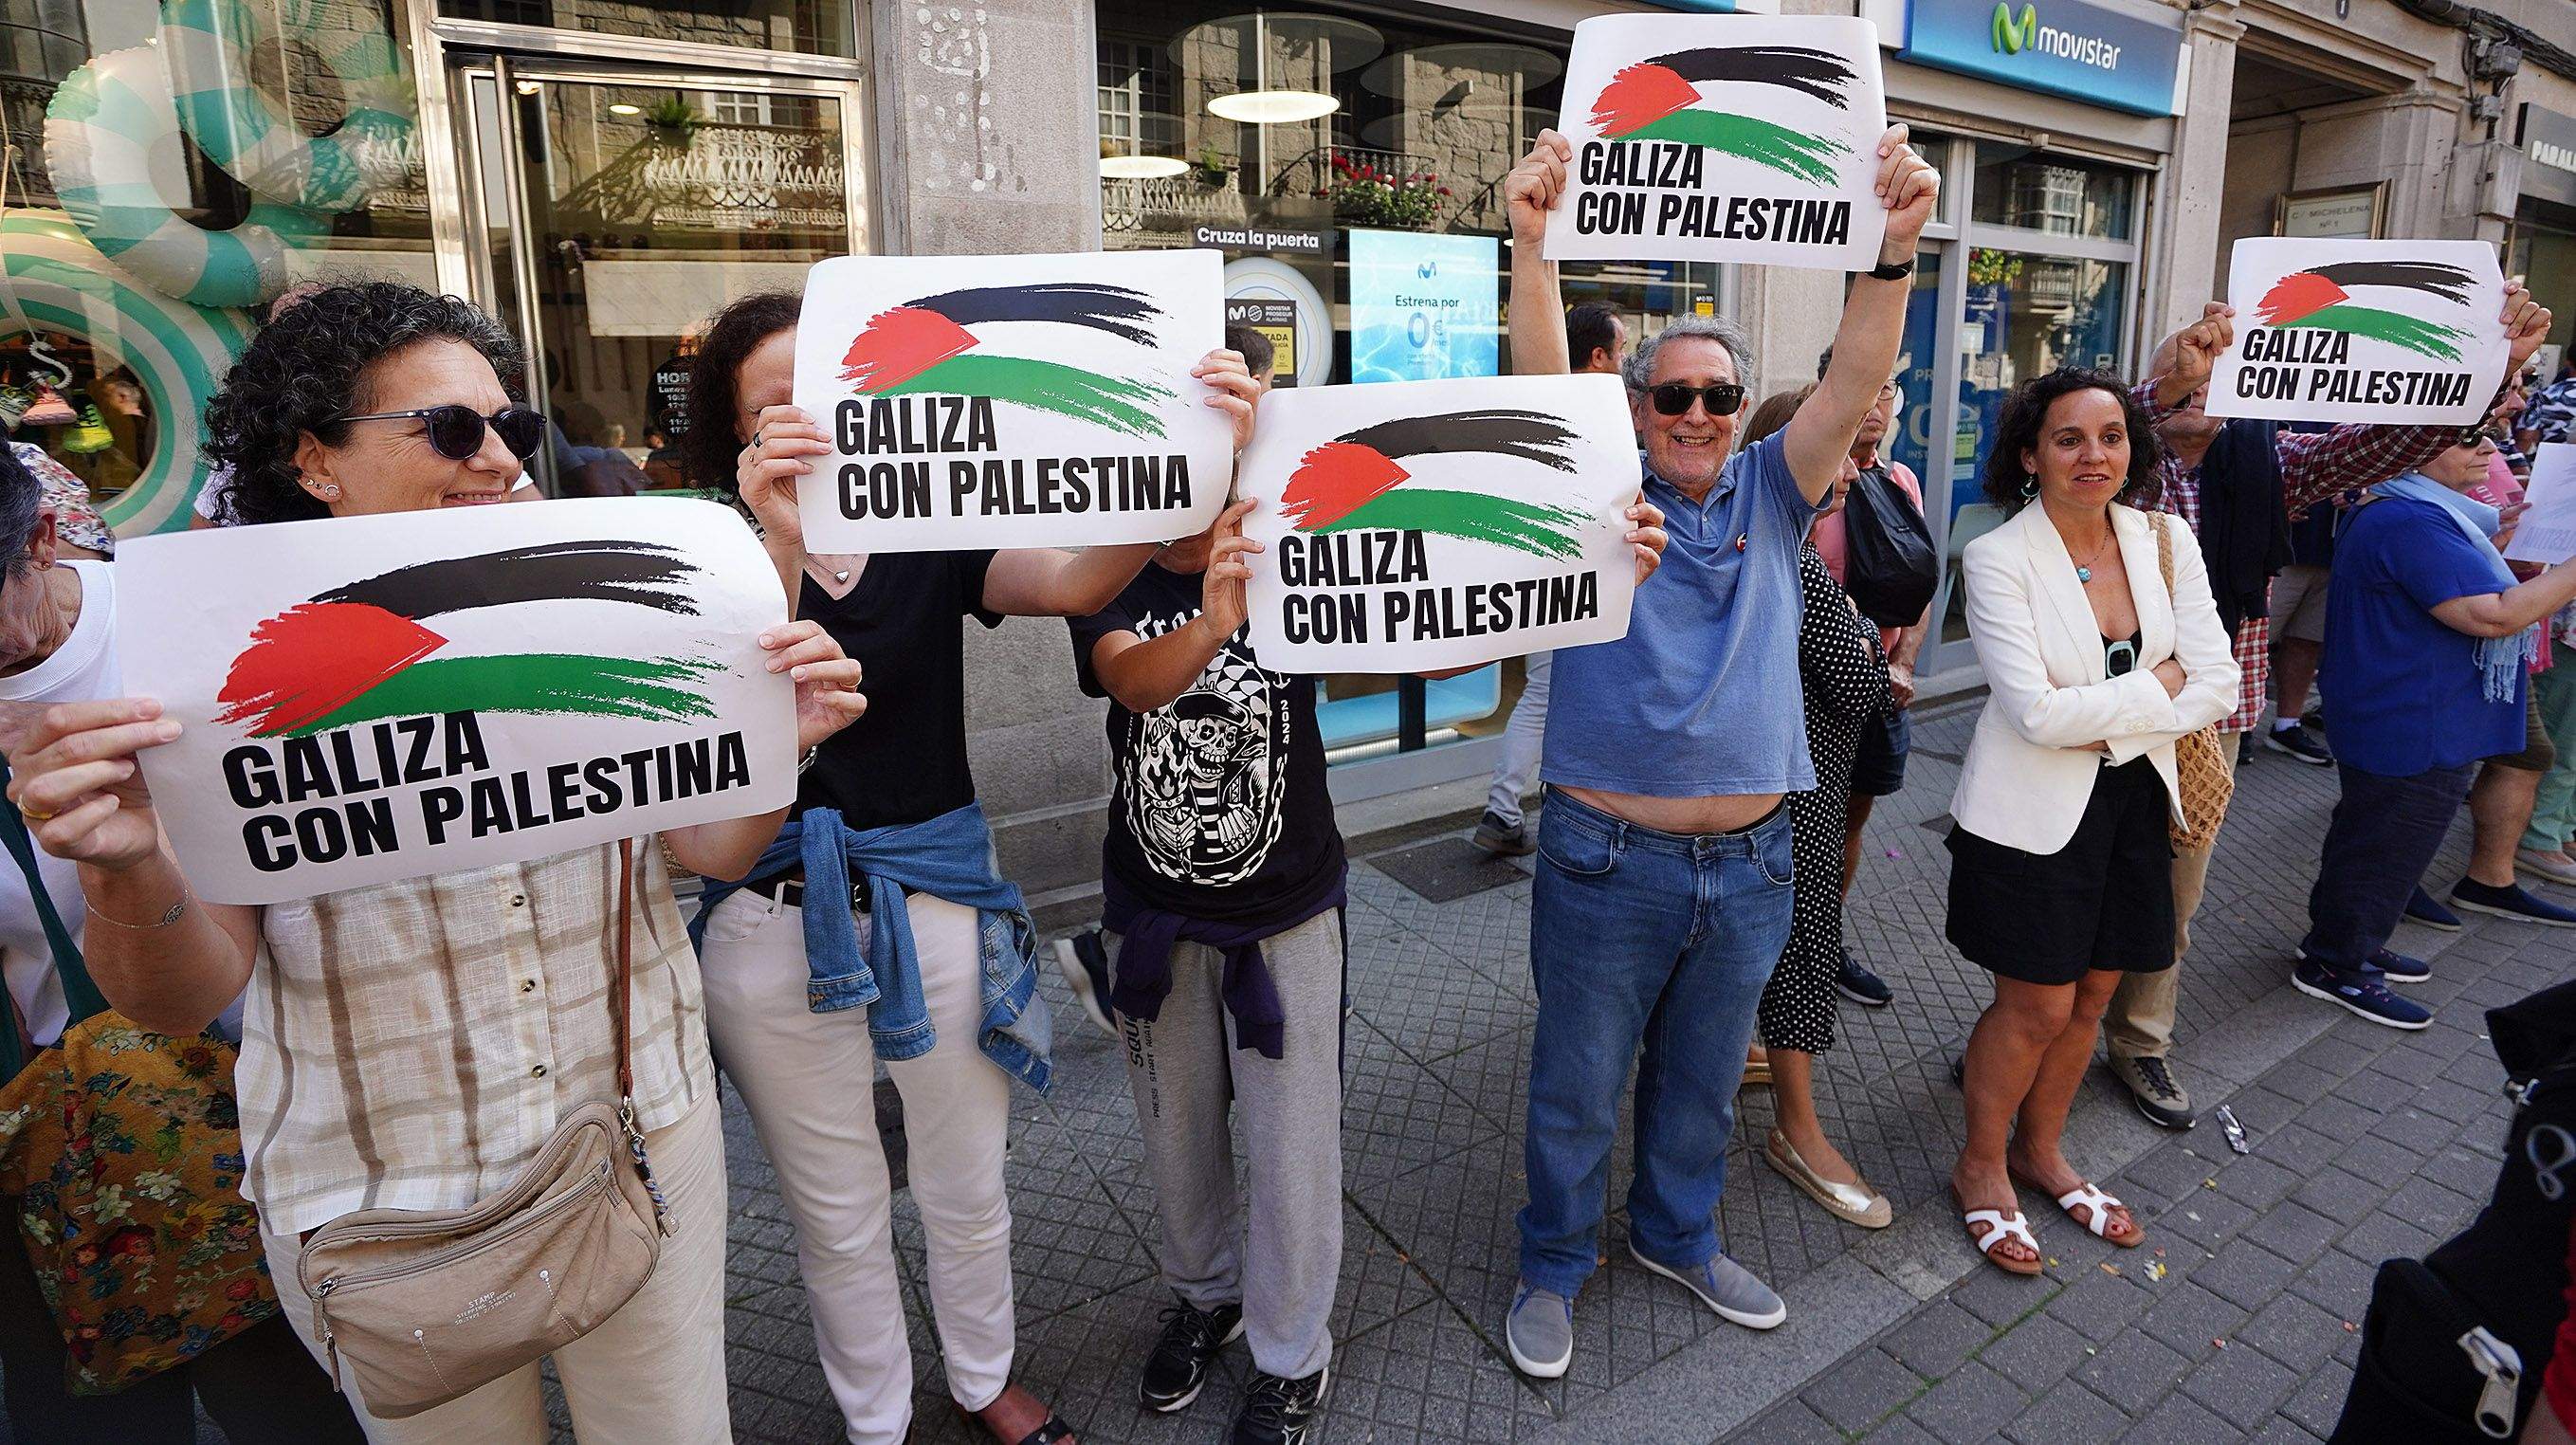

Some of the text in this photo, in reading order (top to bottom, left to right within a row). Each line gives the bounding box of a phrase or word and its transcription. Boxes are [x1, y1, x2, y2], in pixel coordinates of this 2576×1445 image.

[2038, 26, 2121, 70] movistar
[1580, 141, 1705, 190] GALIZA
[1197, 227, 1319, 250] Cruza la puerta
[1576, 191, 1852, 246] CON PALESTINA
[1395, 295, 1460, 310] Estrena por
[2242, 328, 2350, 365] GALIZA
[2236, 365, 2473, 407] CON PALESTINA
[835, 395, 997, 456] GALIZA
[837, 454, 1192, 521] CON PALESTINA
[1278, 528, 1429, 588] GALIZA
[1283, 570, 1599, 645] CON PALESTINA
[1280, 699, 1290, 745] 2024
[222, 709, 490, 810] GALIZA
[242, 729, 751, 872] CON PALESTINA
[1147, 1052, 1157, 1082] START
[1152, 1088, 1160, 1118] PRESS
[468, 1291, 495, 1308] STAMP
